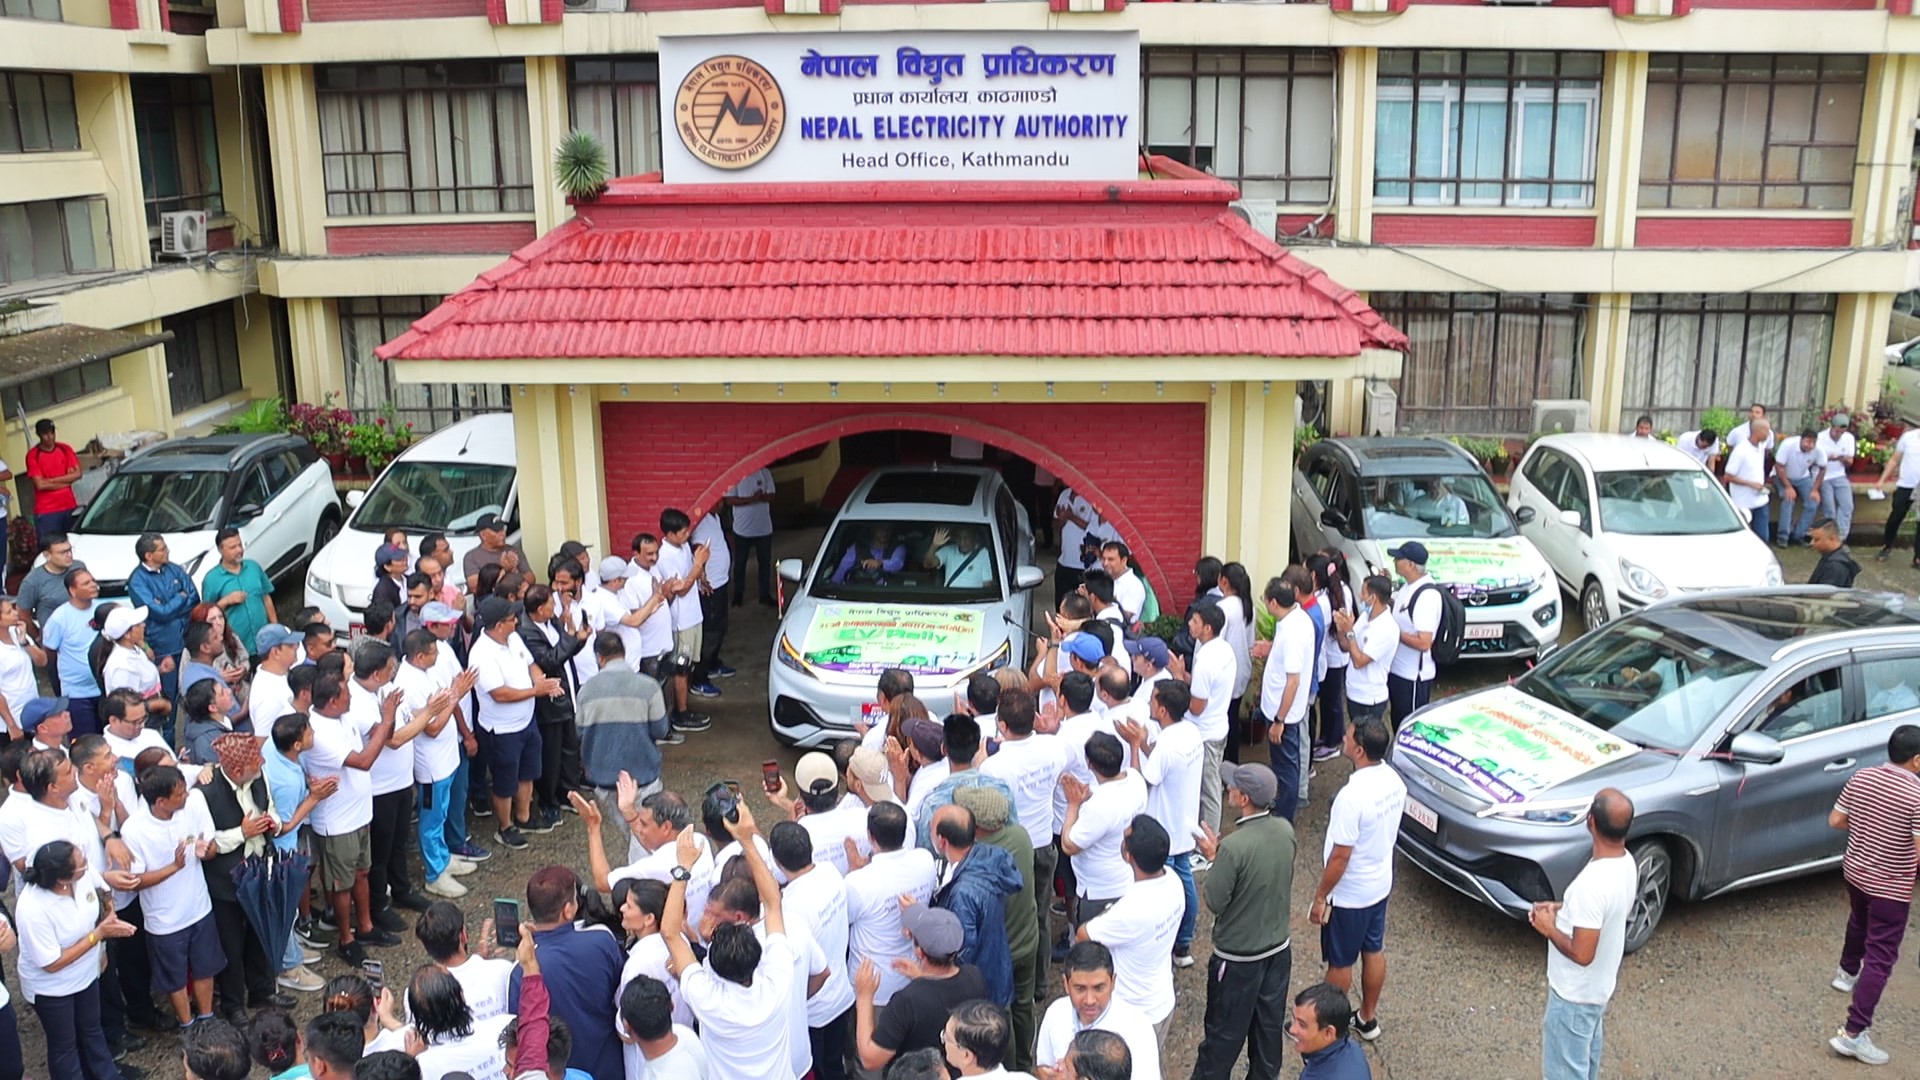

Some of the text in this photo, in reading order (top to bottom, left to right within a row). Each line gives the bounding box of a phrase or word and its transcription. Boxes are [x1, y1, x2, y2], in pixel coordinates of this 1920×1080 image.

[800, 46, 1116, 84] नेपाल विद्युत प्राधिकरण
[853, 91, 893, 107] प्रधान
[801, 114, 1128, 139] NEPAL ELECTRICITY AUTHORITY
[682, 118, 779, 163] NEPAL ELECTRICITY AUTHORITY
[842, 151, 1069, 169] Head Office, Kathmandu
